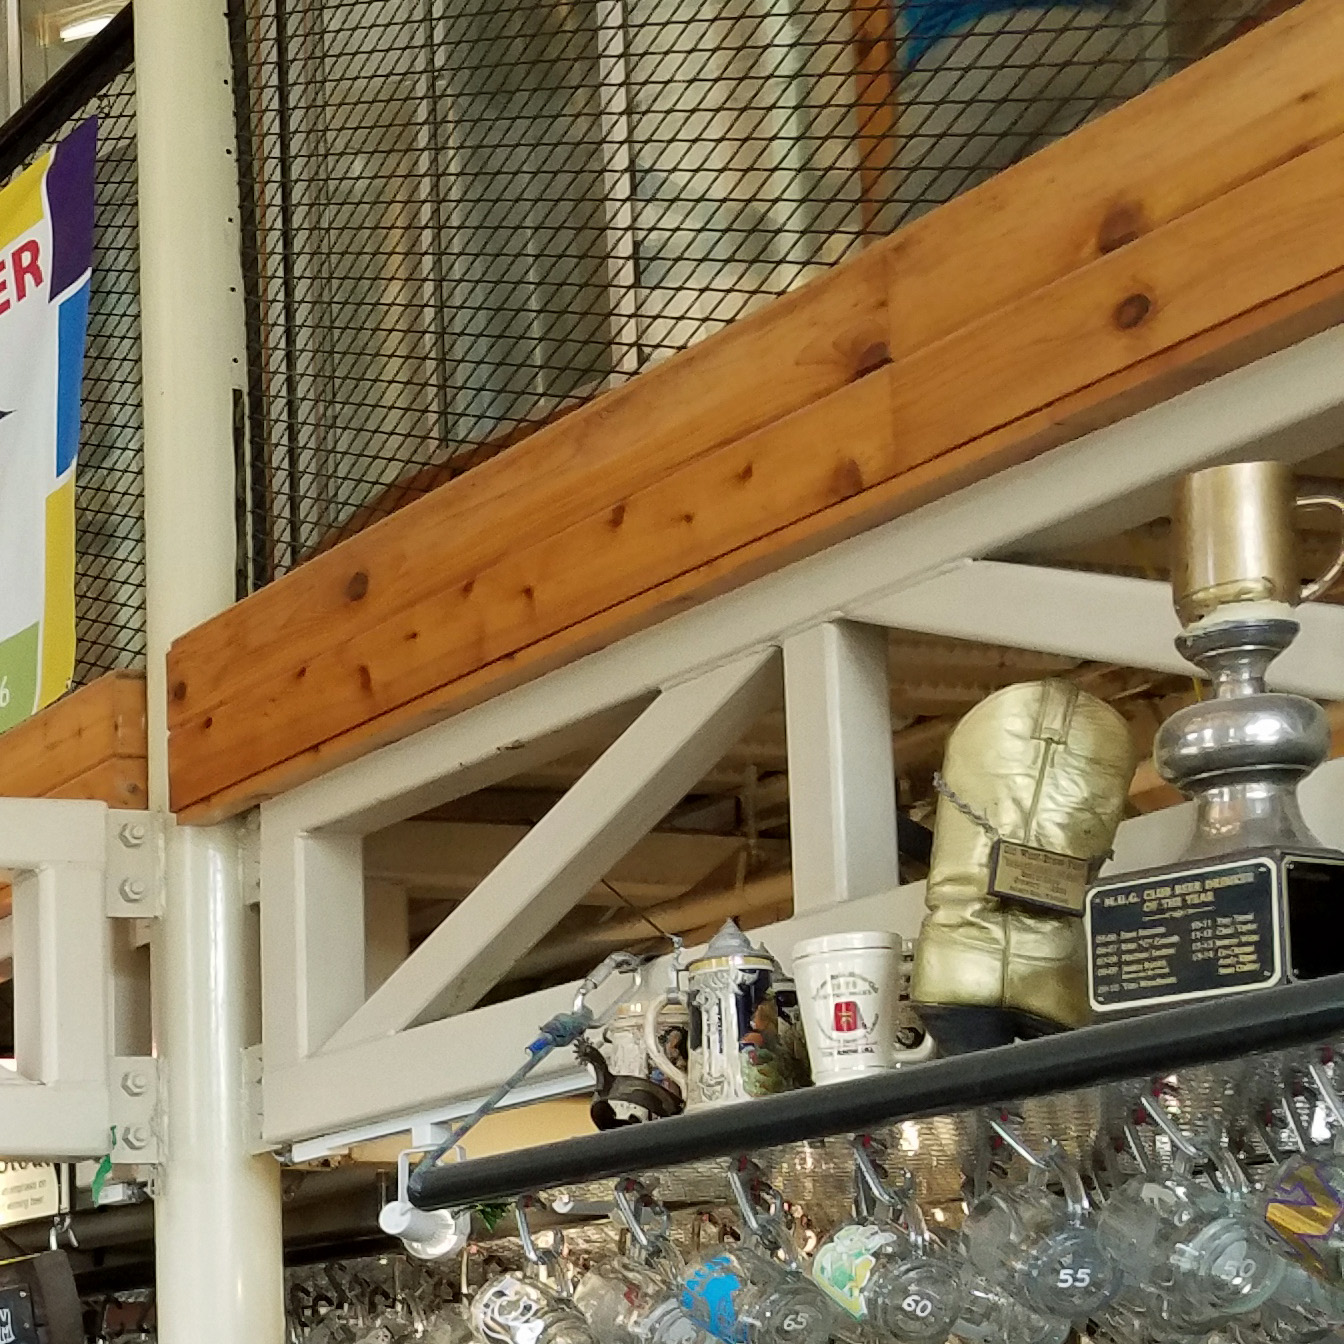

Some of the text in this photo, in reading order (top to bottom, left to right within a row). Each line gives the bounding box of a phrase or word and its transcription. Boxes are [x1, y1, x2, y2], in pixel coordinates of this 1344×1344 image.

[1056, 1267, 1093, 1290] 55
[900, 1294, 933, 1318] 60
[783, 1312, 810, 1333] 65
